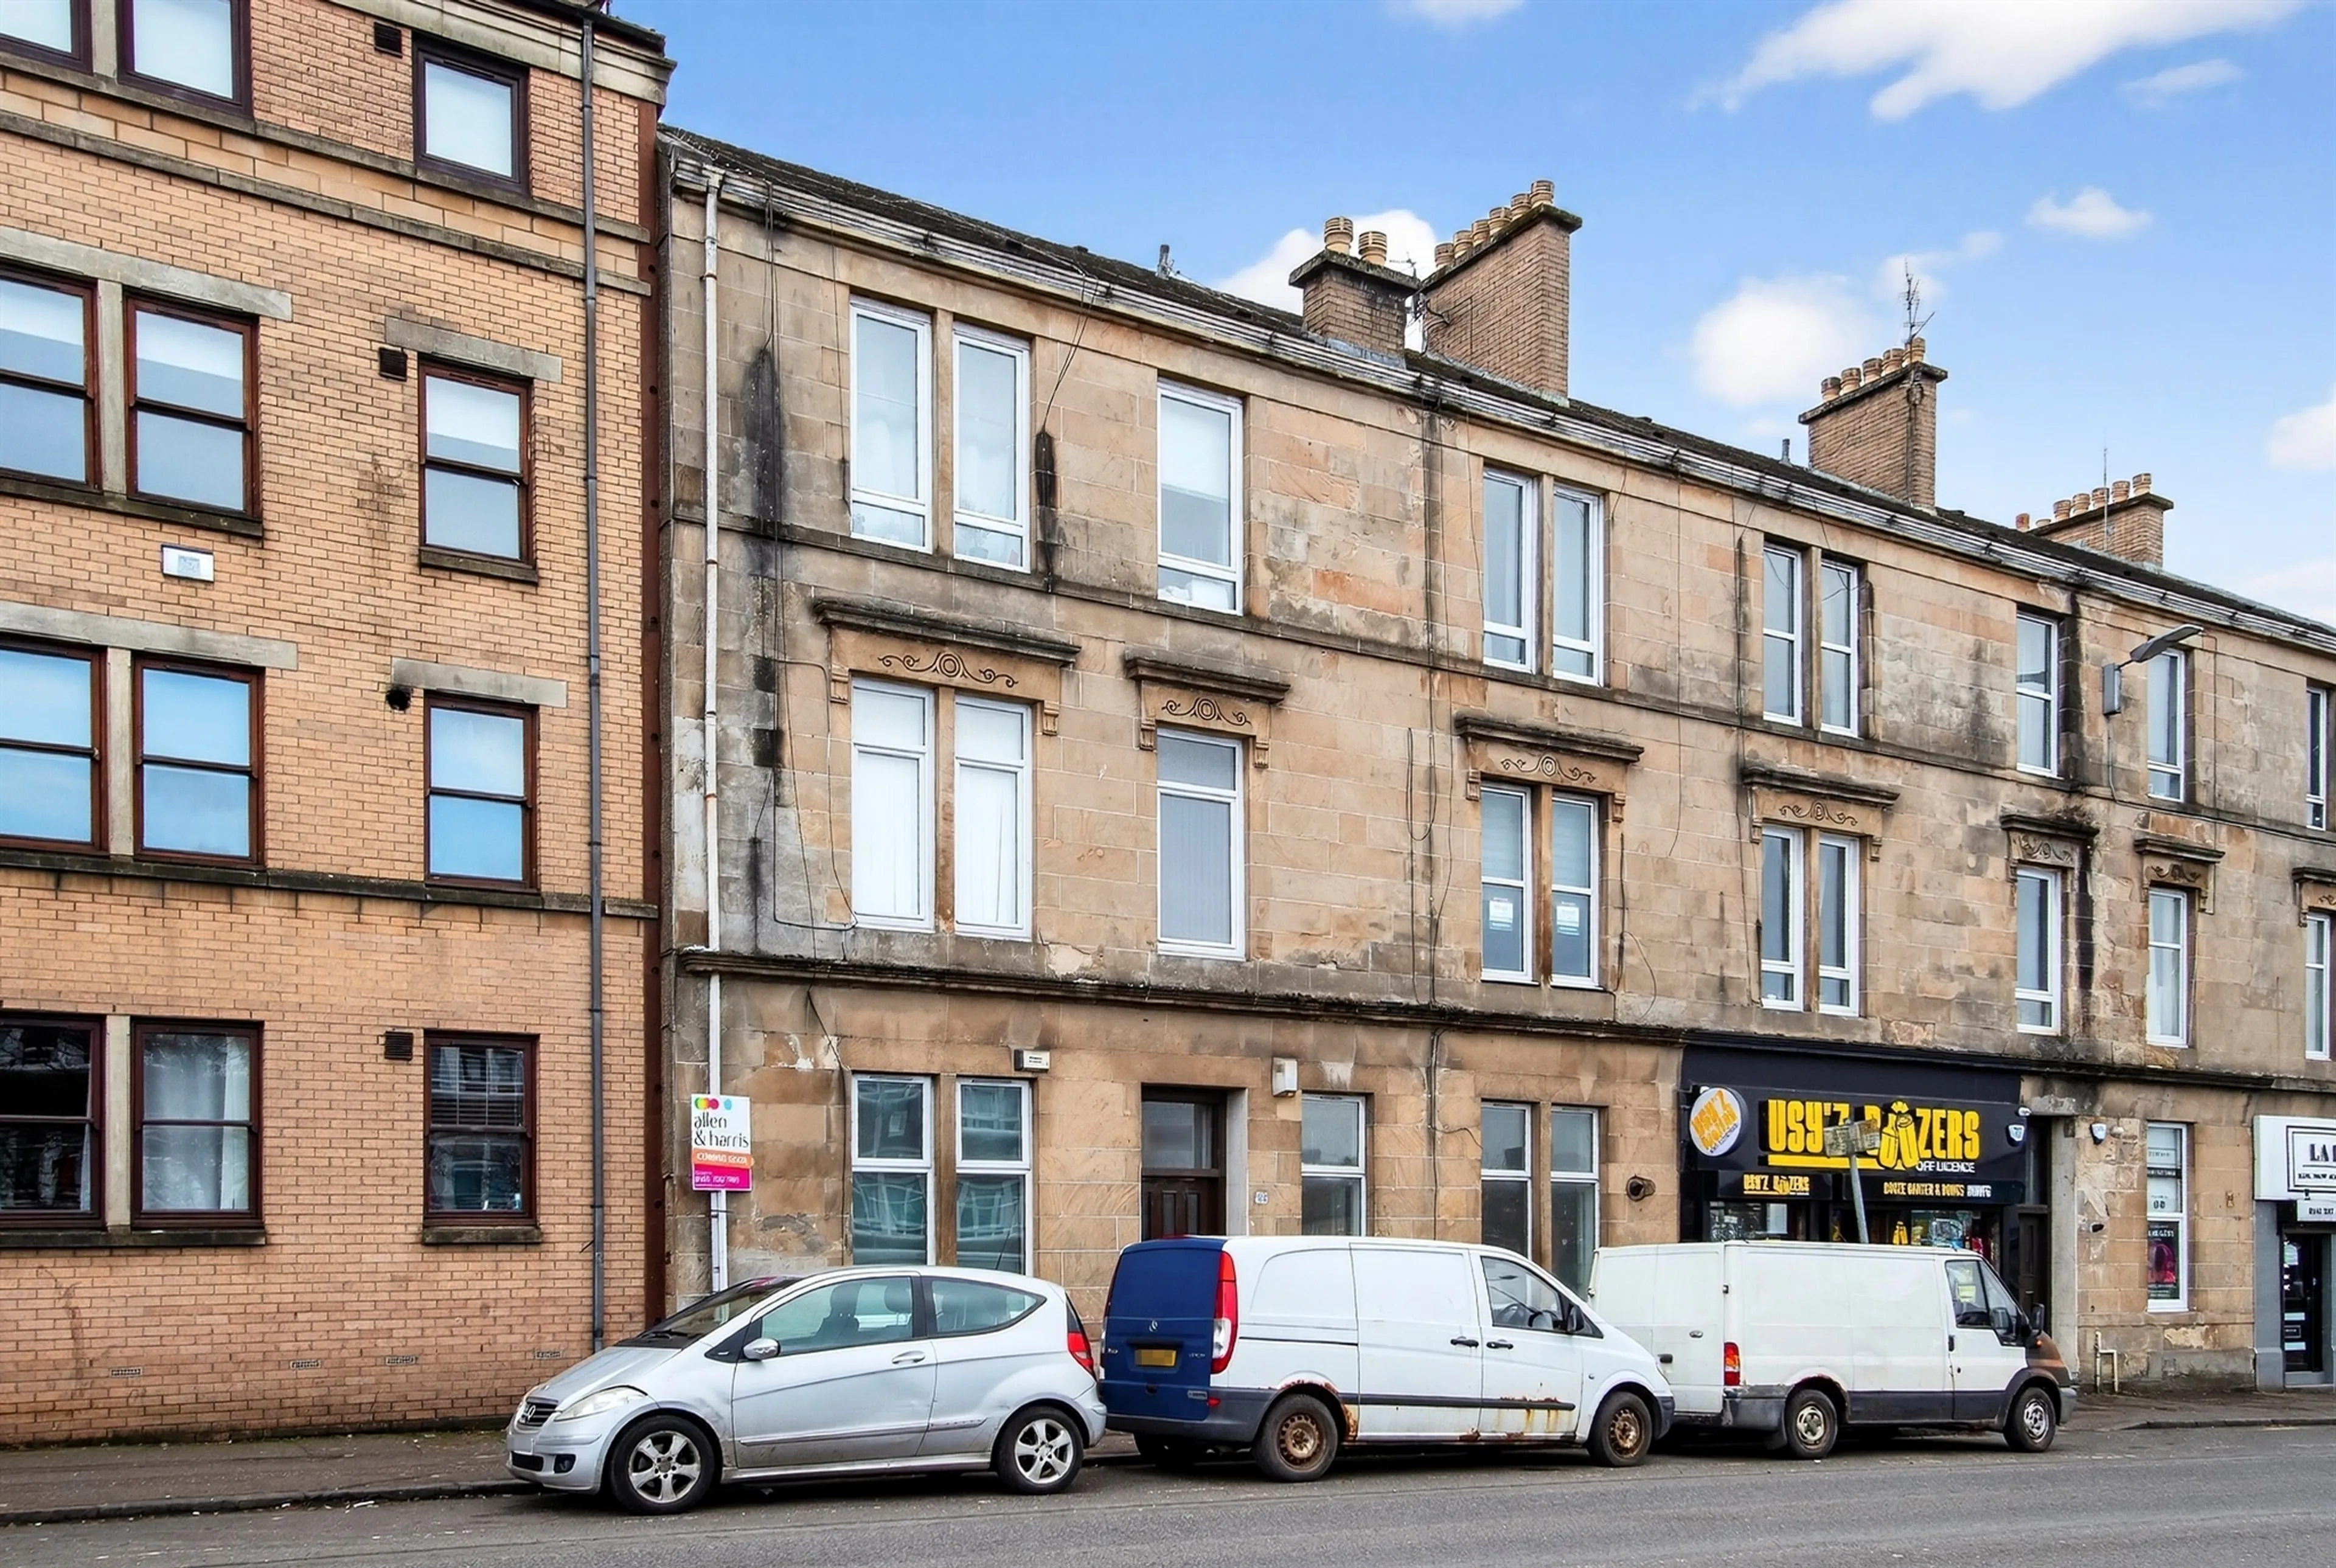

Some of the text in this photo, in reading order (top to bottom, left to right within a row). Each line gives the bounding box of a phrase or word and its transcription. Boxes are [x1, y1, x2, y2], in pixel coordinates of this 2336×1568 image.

[694, 1111, 727, 1129] allen
[694, 1129, 749, 1148] & harris
